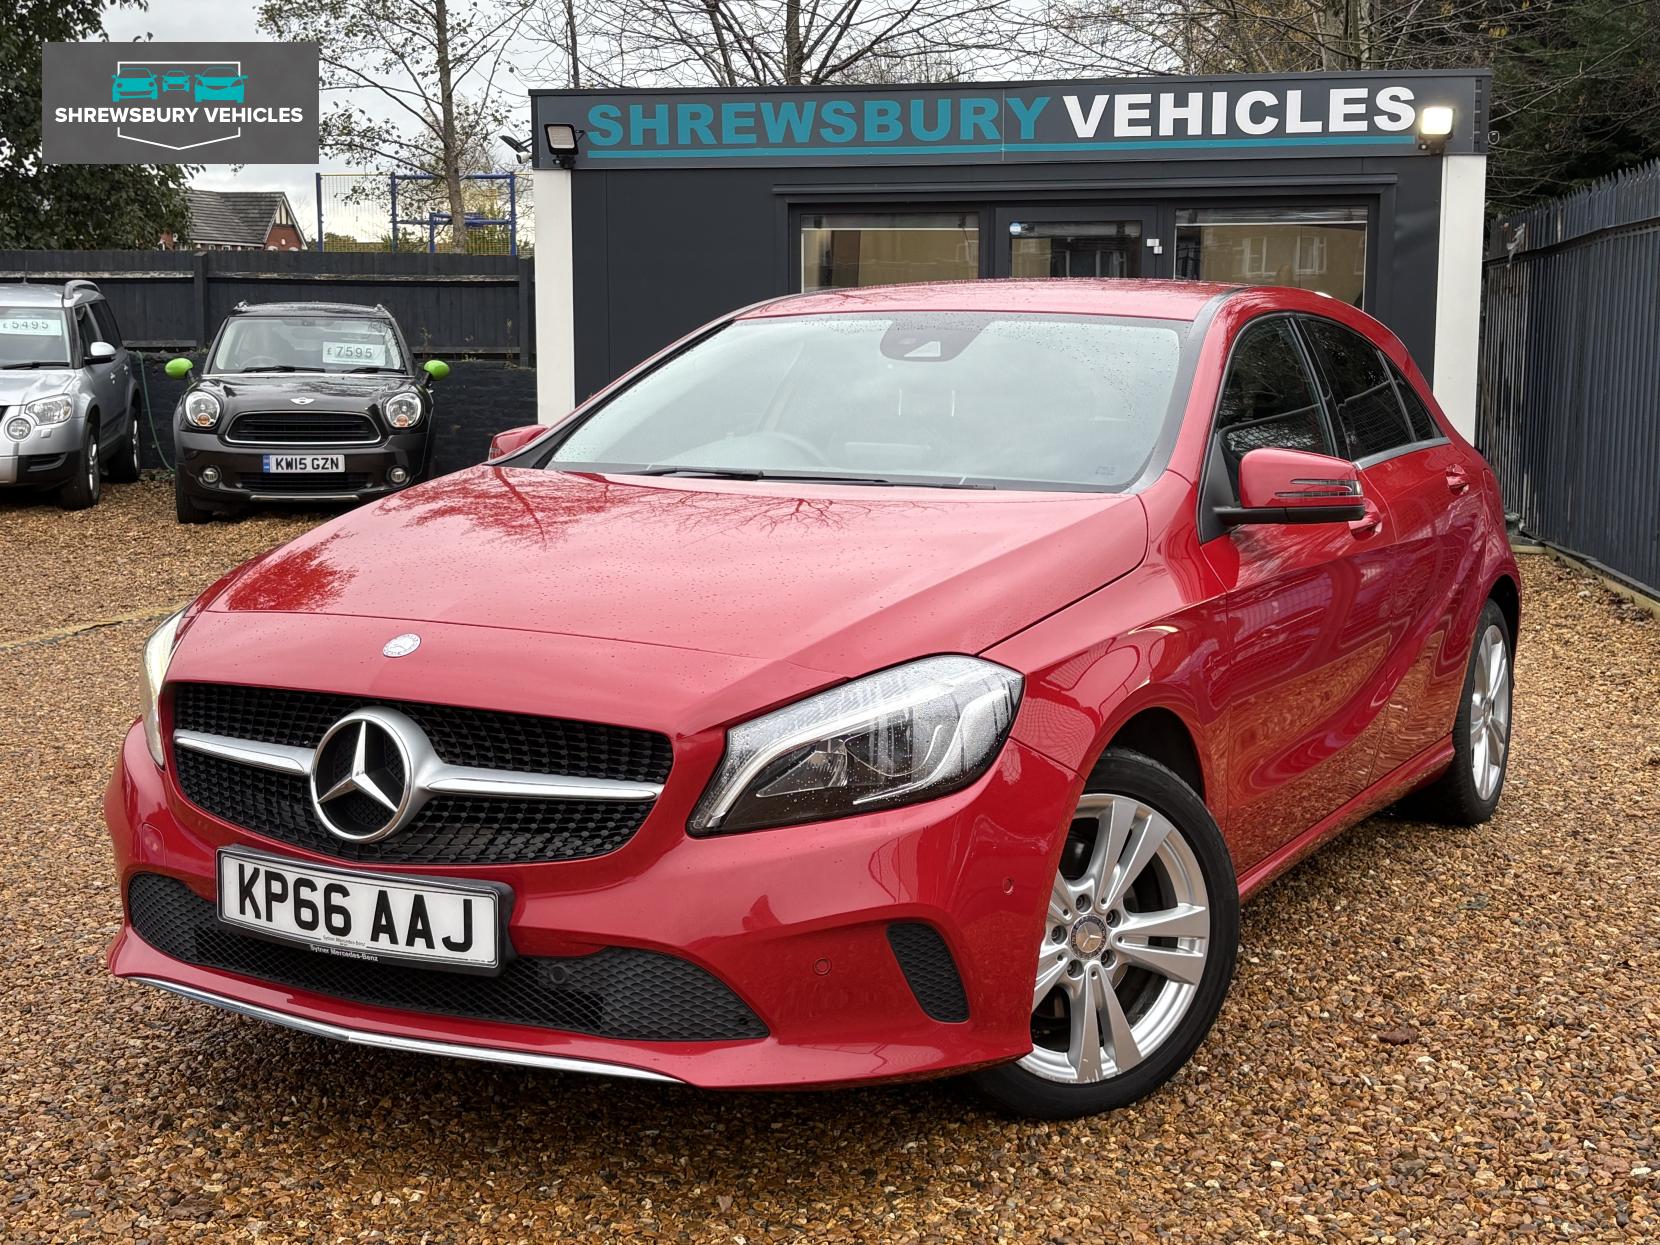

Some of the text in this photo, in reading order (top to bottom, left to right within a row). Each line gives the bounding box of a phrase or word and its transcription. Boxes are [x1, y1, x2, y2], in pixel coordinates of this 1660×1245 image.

[587, 86, 1416, 147] SHREWSBURY VEHICLES
[275, 457, 340, 471] KW15 GZN
[238, 863, 474, 953] KP66 AAJ
[330, 947, 379, 962] Mercedes-Benz
